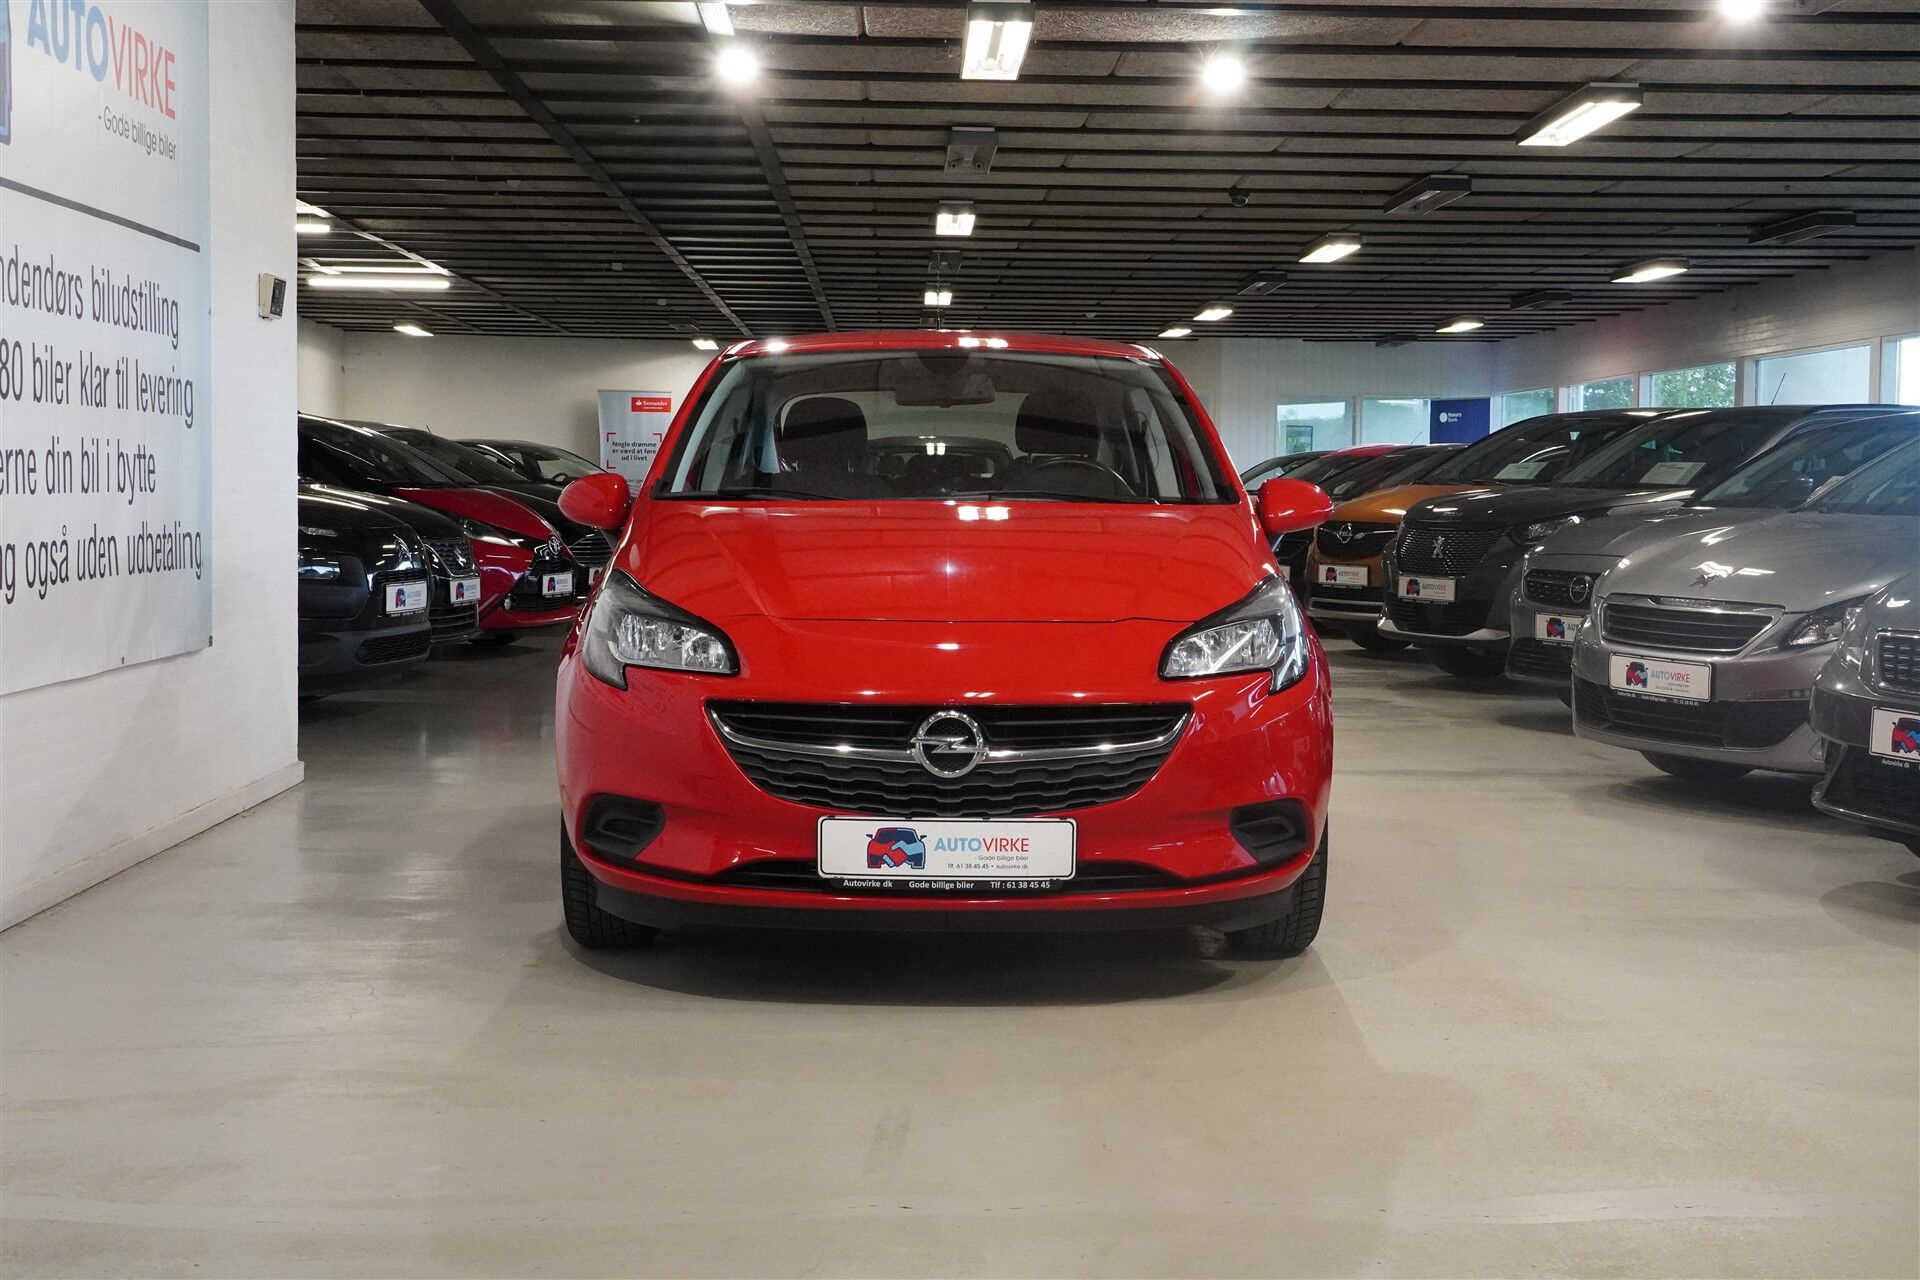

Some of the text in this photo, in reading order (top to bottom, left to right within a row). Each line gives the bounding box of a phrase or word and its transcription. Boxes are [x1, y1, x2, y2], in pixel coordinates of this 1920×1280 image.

[27, 0, 176, 120] AUTOVIRKE
[104, 105, 130, 139] Gode
[132, 119, 157, 156] billige
[159, 132, 176, 161] biler
[91, 264, 179, 350] biludstilling
[32, 341, 72, 405] biler
[80, 349, 110, 410] klar
[116, 357, 130, 411] til
[135, 358, 194, 429] levering
[46, 435, 73, 495] din
[81, 436, 100, 495] bil
[106, 438, 110, 494] i
[117, 439, 157, 506] bytte
[26, 524, 70, 600] også
[77, 524, 120, 581] uden
[1650, 670, 1690, 682] AUTOVIRKE
[934, 837, 1030, 853] AUTOVIRKE
[908, 880, 930, 888] Gode
[931, 880, 955, 890] billige
[956, 881, 975, 889] biler
[990, 881, 1001, 889] Tlf
[1007, 881, 1016, 889] 61
[1018, 881, 1028, 889] 38
[1029, 881, 1039, 889] 45
[1040, 881, 1051, 889] 45
